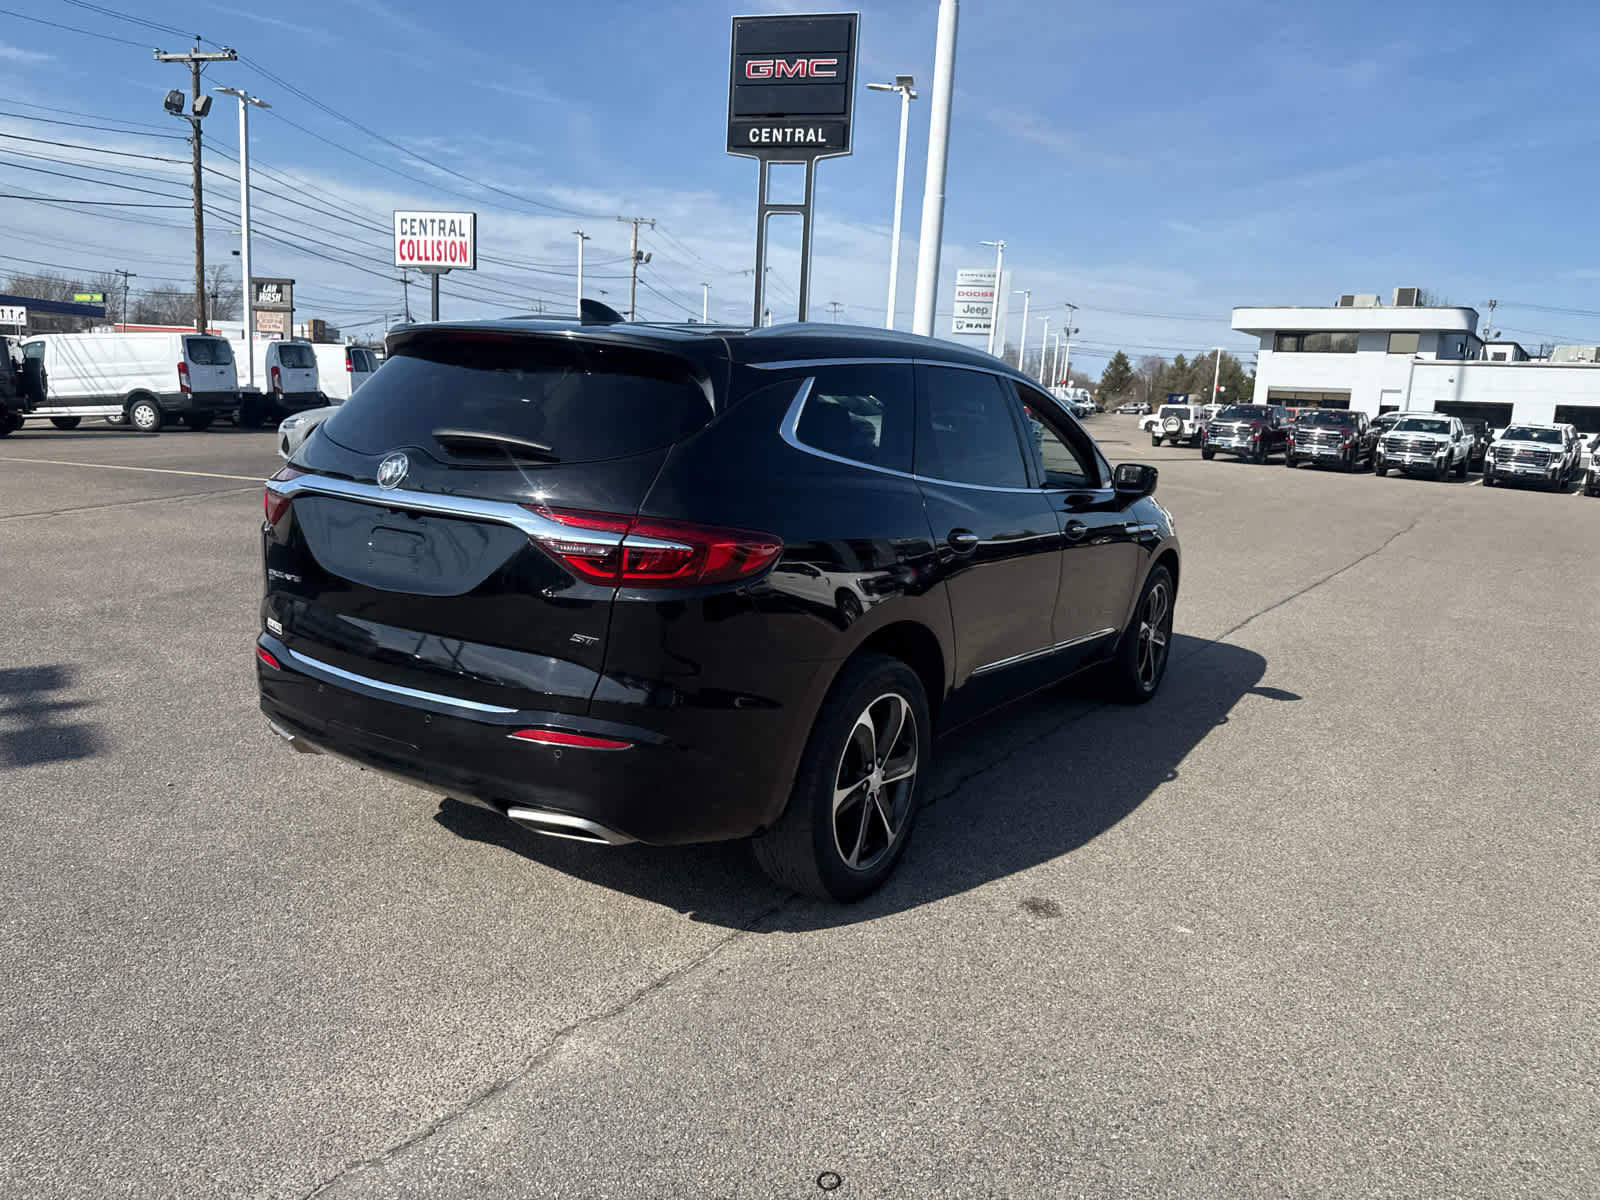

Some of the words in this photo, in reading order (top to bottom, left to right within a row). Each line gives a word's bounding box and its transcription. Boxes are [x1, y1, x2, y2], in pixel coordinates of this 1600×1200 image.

[746, 59, 837, 78] GMC
[749, 128, 826, 142] CENTRAL
[400, 218, 466, 237] CENTRAL
[399, 239, 467, 263] COLLISION
[258, 292, 282, 303] WASH
[963, 304, 989, 316] Jeep
